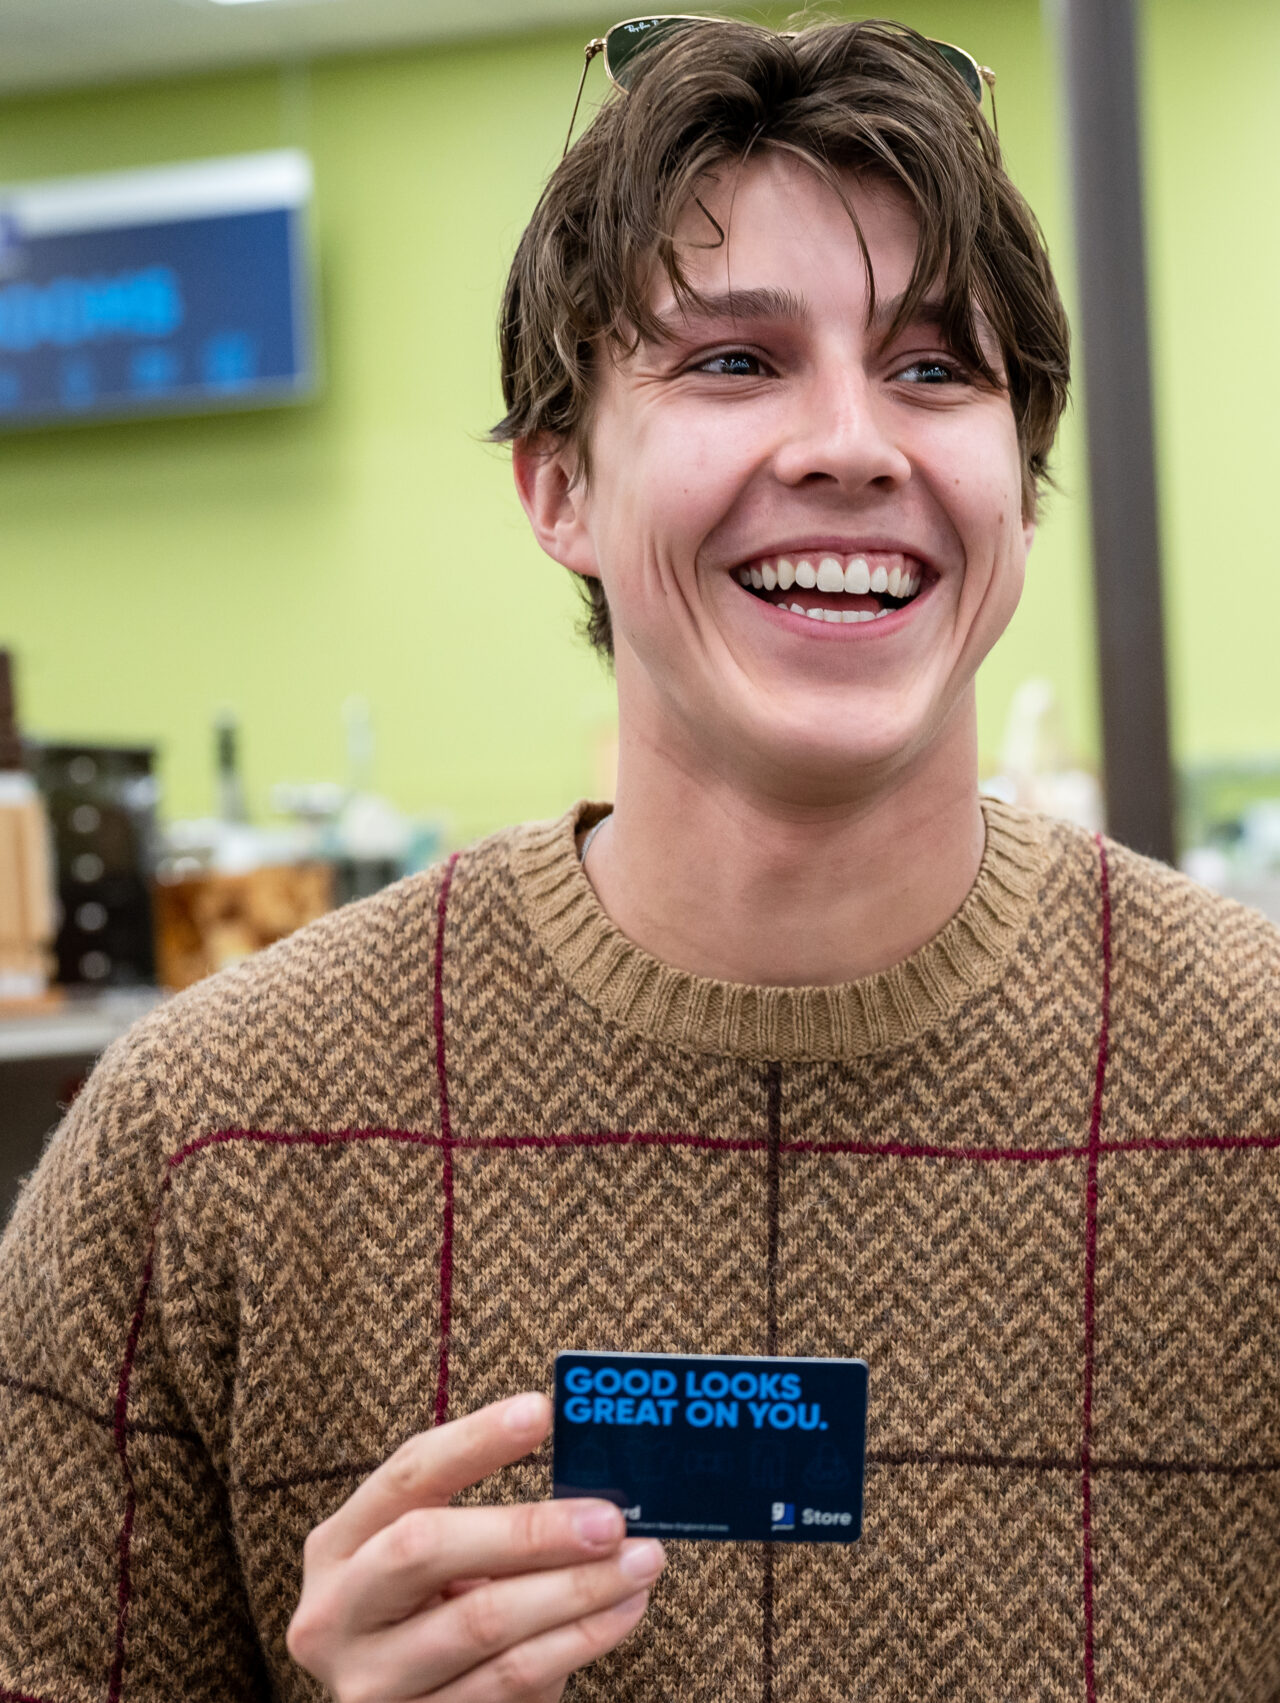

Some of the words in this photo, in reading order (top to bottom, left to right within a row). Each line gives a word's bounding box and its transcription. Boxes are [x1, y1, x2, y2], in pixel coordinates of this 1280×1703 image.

[564, 1366, 678, 1397] GOOD
[685, 1370, 802, 1401] LOOKS
[564, 1396, 679, 1426] GREAT
[685, 1400, 739, 1428] ON
[747, 1401, 829, 1431] YOU.
[801, 1507, 852, 1526] Store
